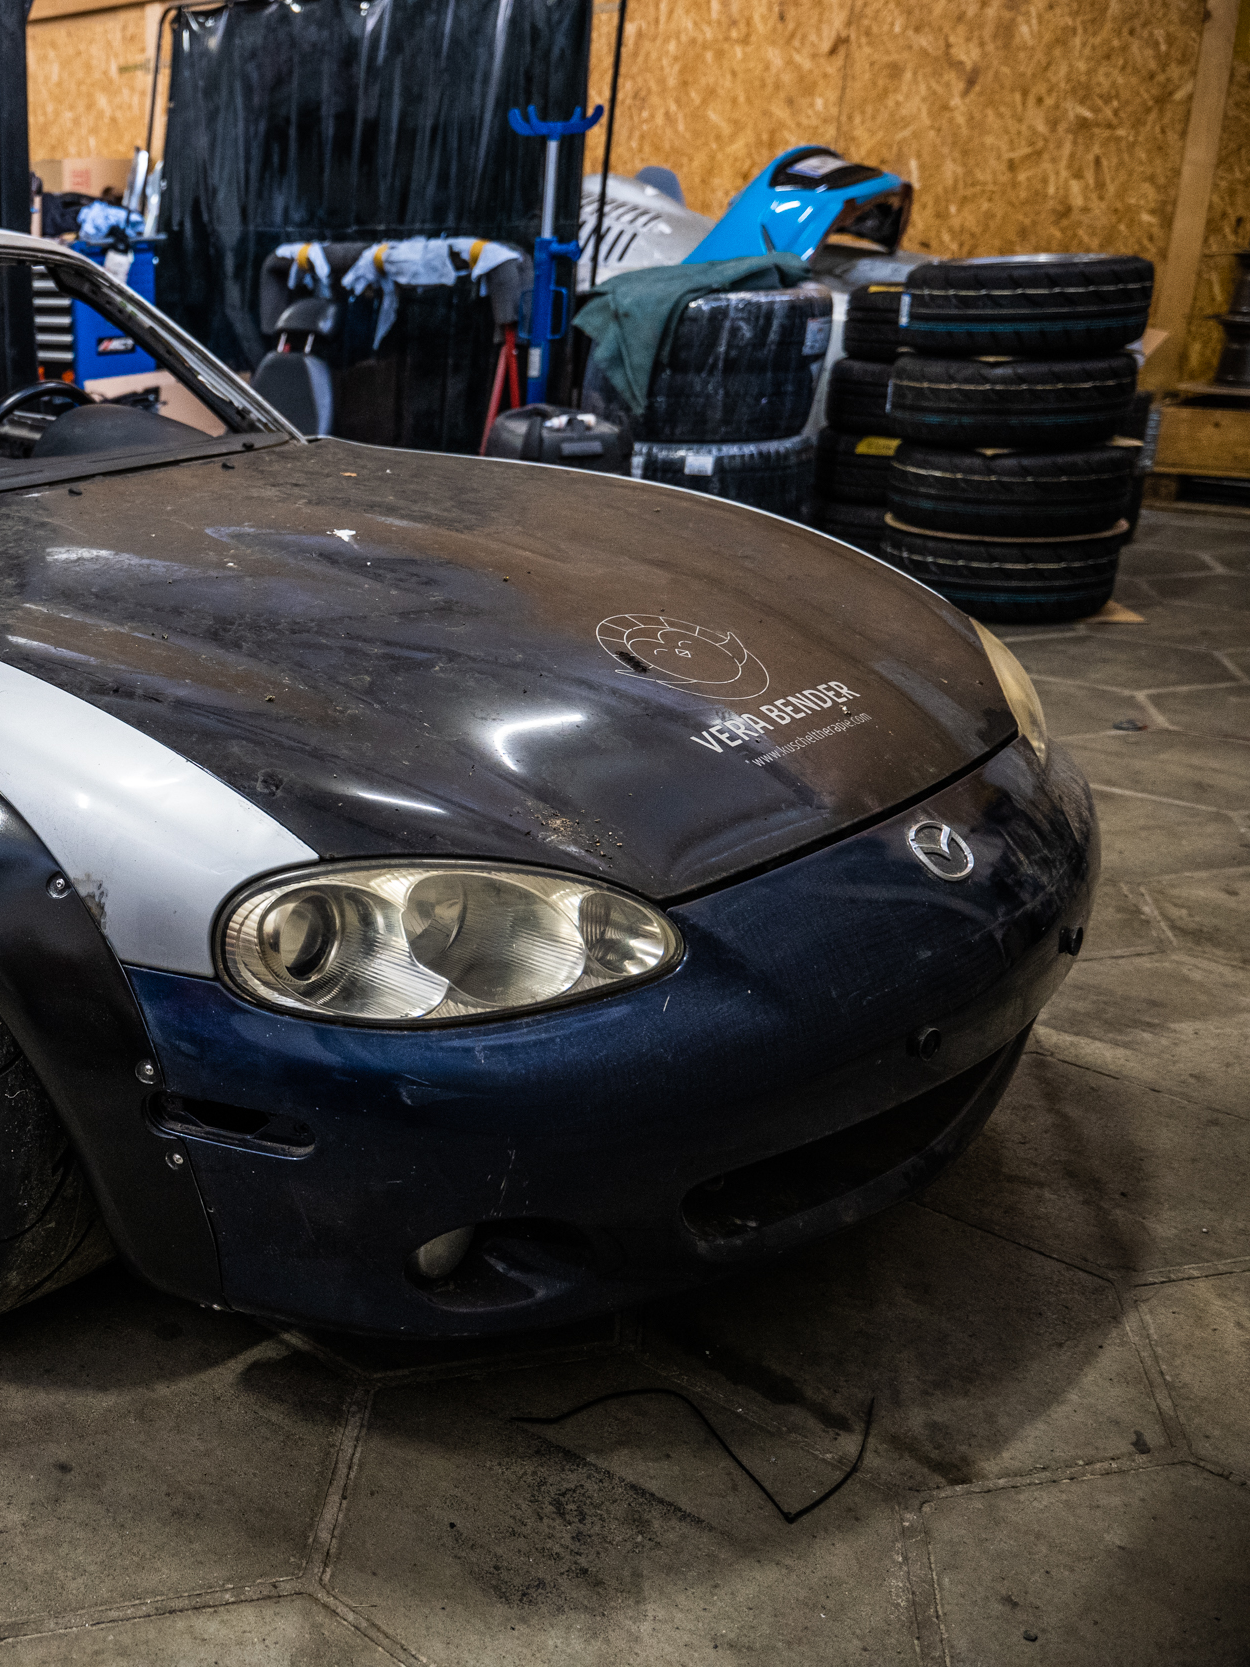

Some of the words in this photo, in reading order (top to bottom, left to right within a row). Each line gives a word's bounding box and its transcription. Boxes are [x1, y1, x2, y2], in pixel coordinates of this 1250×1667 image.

[689, 713, 774, 753] VERA
[759, 681, 861, 725] BENDER
[751, 712, 873, 767] www.kuscheltherapie.com
